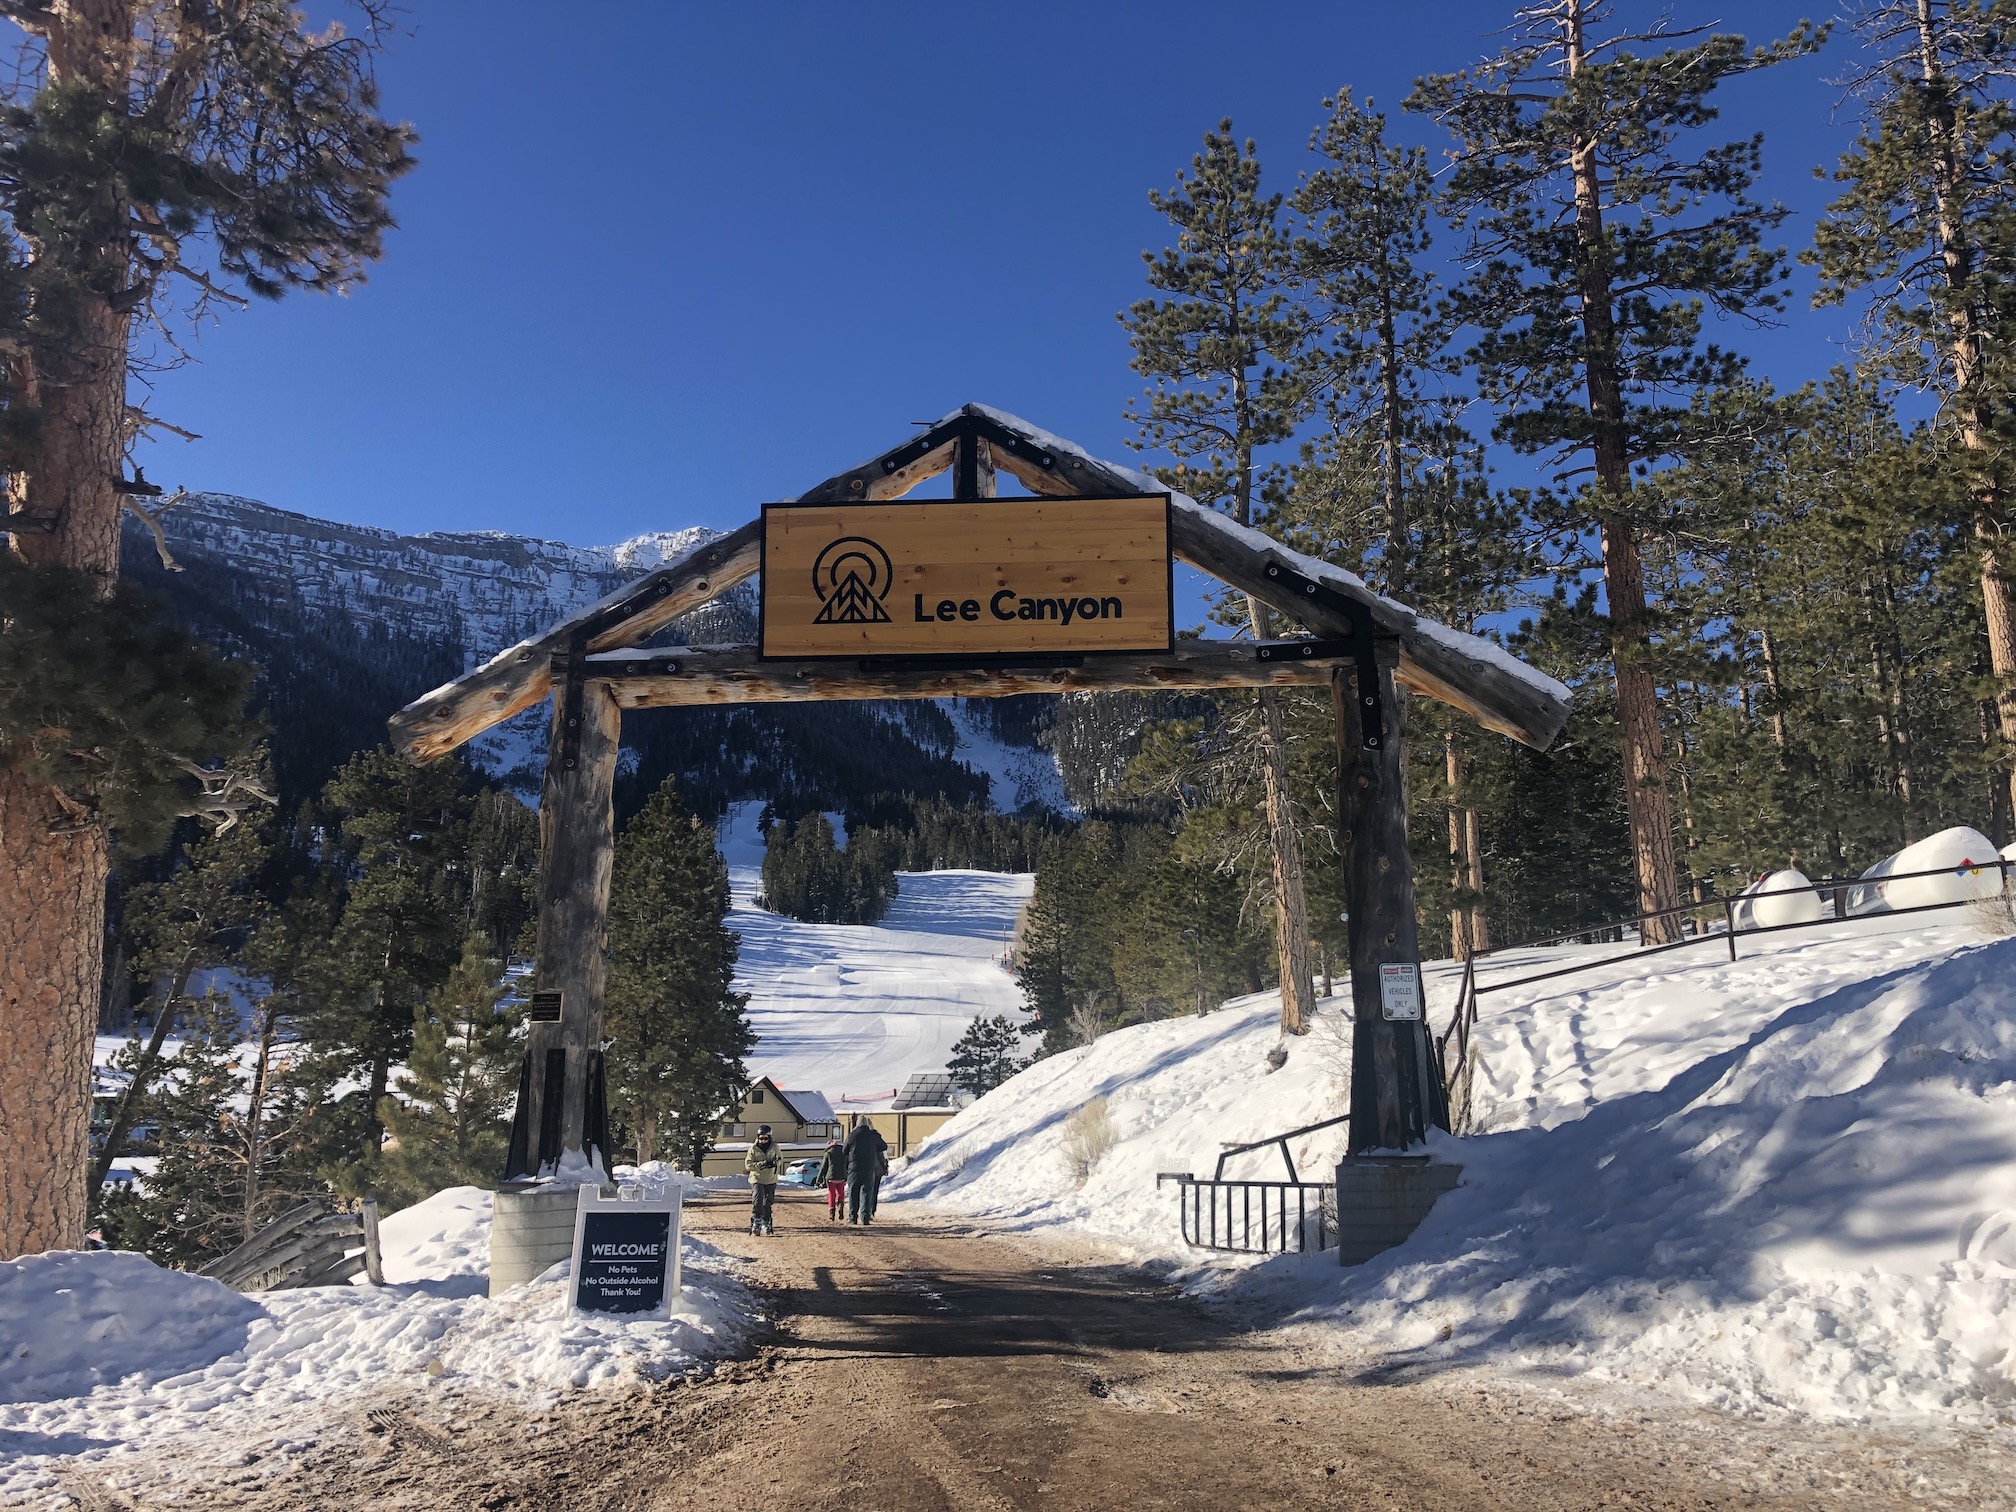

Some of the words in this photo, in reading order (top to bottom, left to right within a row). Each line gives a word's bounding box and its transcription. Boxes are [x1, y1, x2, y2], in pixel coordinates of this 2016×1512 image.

[914, 592, 981, 623] Lee
[990, 589, 1122, 626] Canyon
[1384, 975, 1414, 983] AUTHORIZED
[1394, 1000, 1408, 1008] ONLY
[591, 1243, 659, 1256] WELCOME
[608, 1265, 620, 1274] No
[621, 1265, 638, 1274] Pets
[585, 1276, 598, 1285] No
[598, 1276, 629, 1285] Outside
[630, 1276, 658, 1285] Alcohol
[600, 1288, 624, 1296] Thank
[625, 1287, 642, 1296] You!
